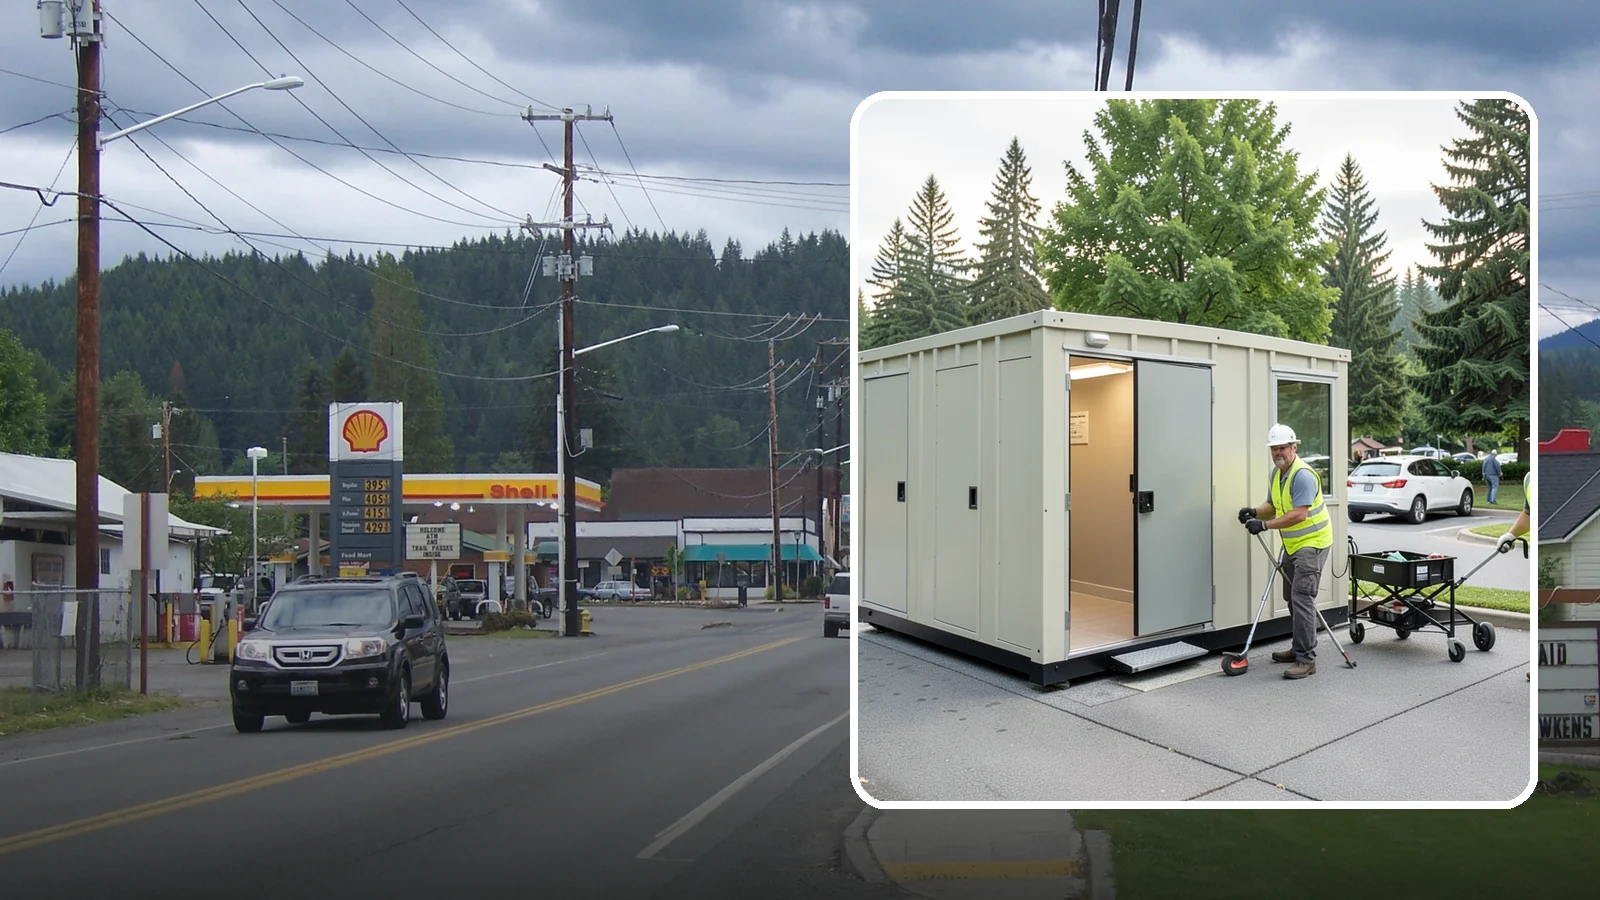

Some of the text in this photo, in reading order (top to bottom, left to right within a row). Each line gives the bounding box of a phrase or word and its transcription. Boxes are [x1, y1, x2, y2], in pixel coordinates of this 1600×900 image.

[365, 480, 383, 490] 395
[490, 484, 547, 499] Shell
[365, 494, 383, 504] 405
[365, 508, 383, 518] 415
[365, 522, 383, 532] 429
[1538, 643, 1567, 665] AID
